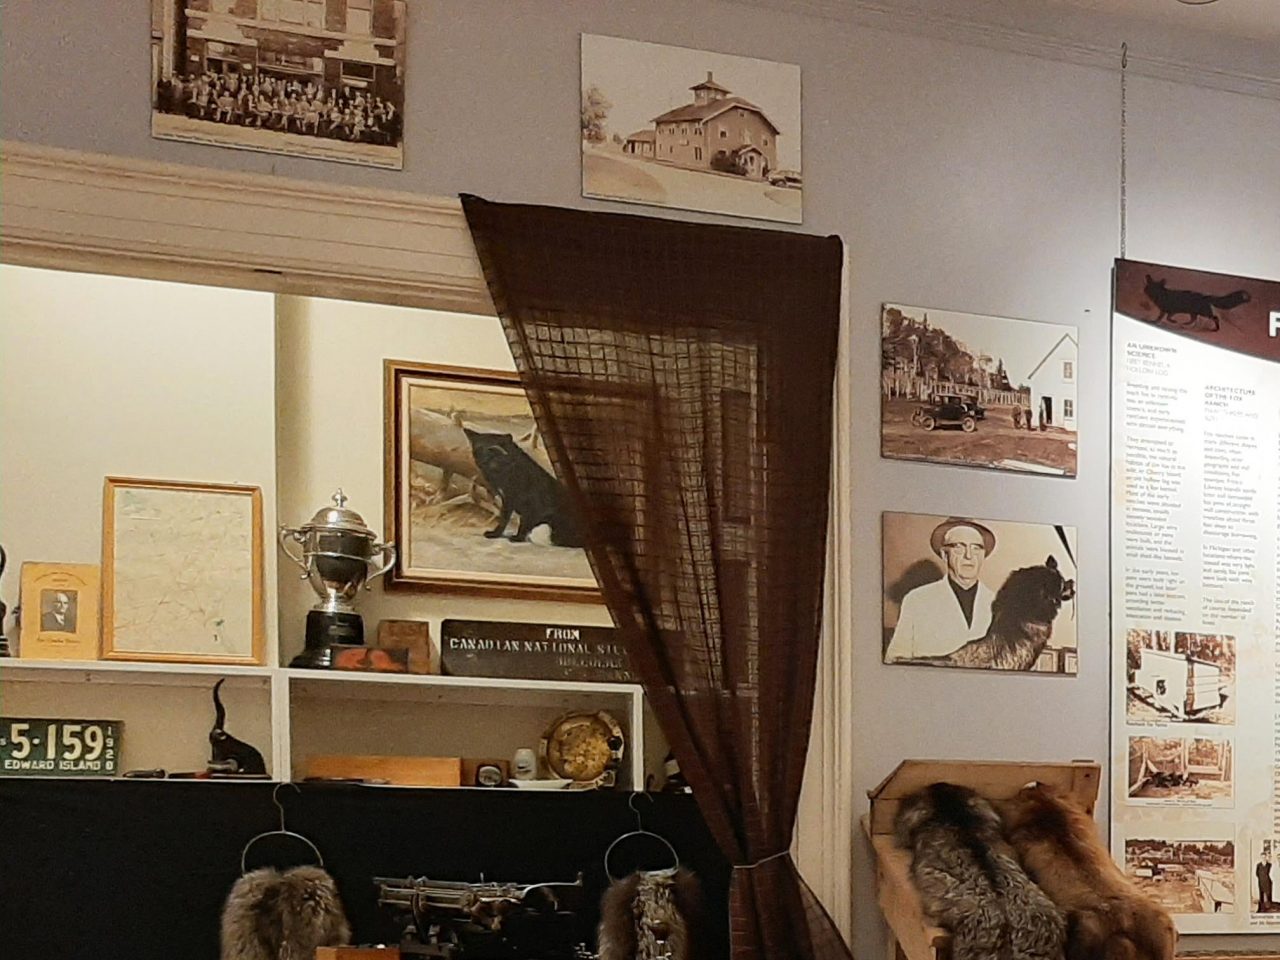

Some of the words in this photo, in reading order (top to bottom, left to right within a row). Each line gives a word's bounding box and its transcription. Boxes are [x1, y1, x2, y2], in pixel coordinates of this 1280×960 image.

[546, 628, 580, 640] FROM
[450, 637, 520, 651] CANADIAN
[524, 640, 592, 655] NATIONAL
[4, 760, 55, 770] EDWARD
[59, 761, 101, 771] ISLAND
